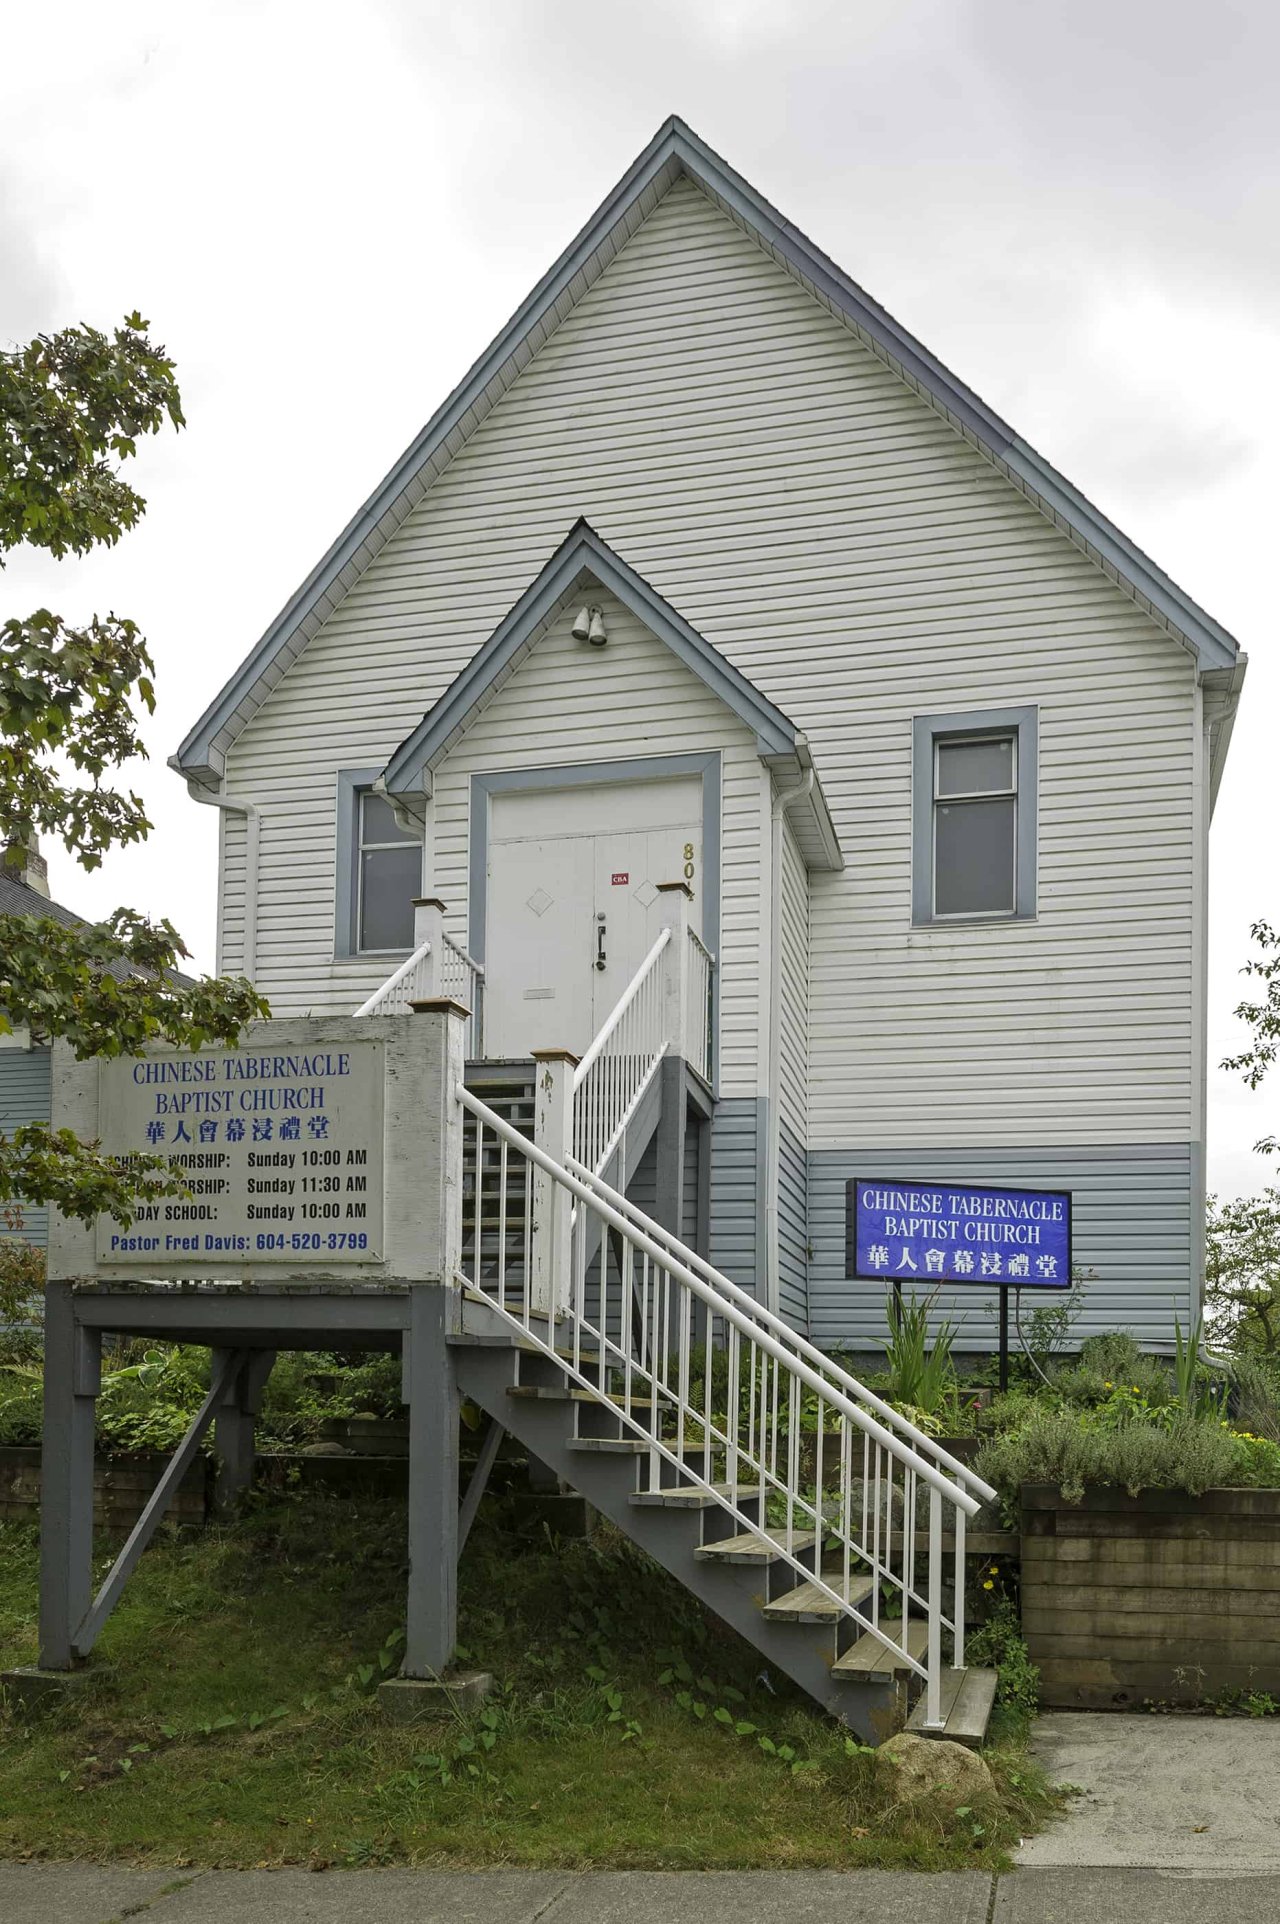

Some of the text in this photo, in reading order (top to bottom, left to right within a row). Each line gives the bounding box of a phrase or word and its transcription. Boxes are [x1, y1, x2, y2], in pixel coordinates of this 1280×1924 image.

[133, 1053, 350, 1085] CHINESE TABERNACLE
[155, 1087, 325, 1114] BAPTIST CHURCH
[144, 1116, 330, 1145] 華人會幕浸禮堂
[247, 1151, 295, 1168] Sunday
[302, 1150, 341, 1166] 10:00
[346, 1150, 367, 1165] AM
[247, 1178, 295, 1195] Sunday
[302, 1177, 341, 1193] 11:30
[346, 1176, 367, 1192] AM
[165, 1205, 218, 1221] SCHOOL:
[247, 1204, 295, 1221] Sunday
[302, 1203, 341, 1219] 10:00
[346, 1203, 367, 1218] AM
[862, 1189, 1063, 1221] CHINESE TABERNACLE
[111, 1233, 368, 1251] Pastor Fred Davis: 604-520-3799
[885, 1217, 1041, 1244] BAPTIST CHURCH
[867, 1244, 1058, 1278] 華人會幕浸禮堂
